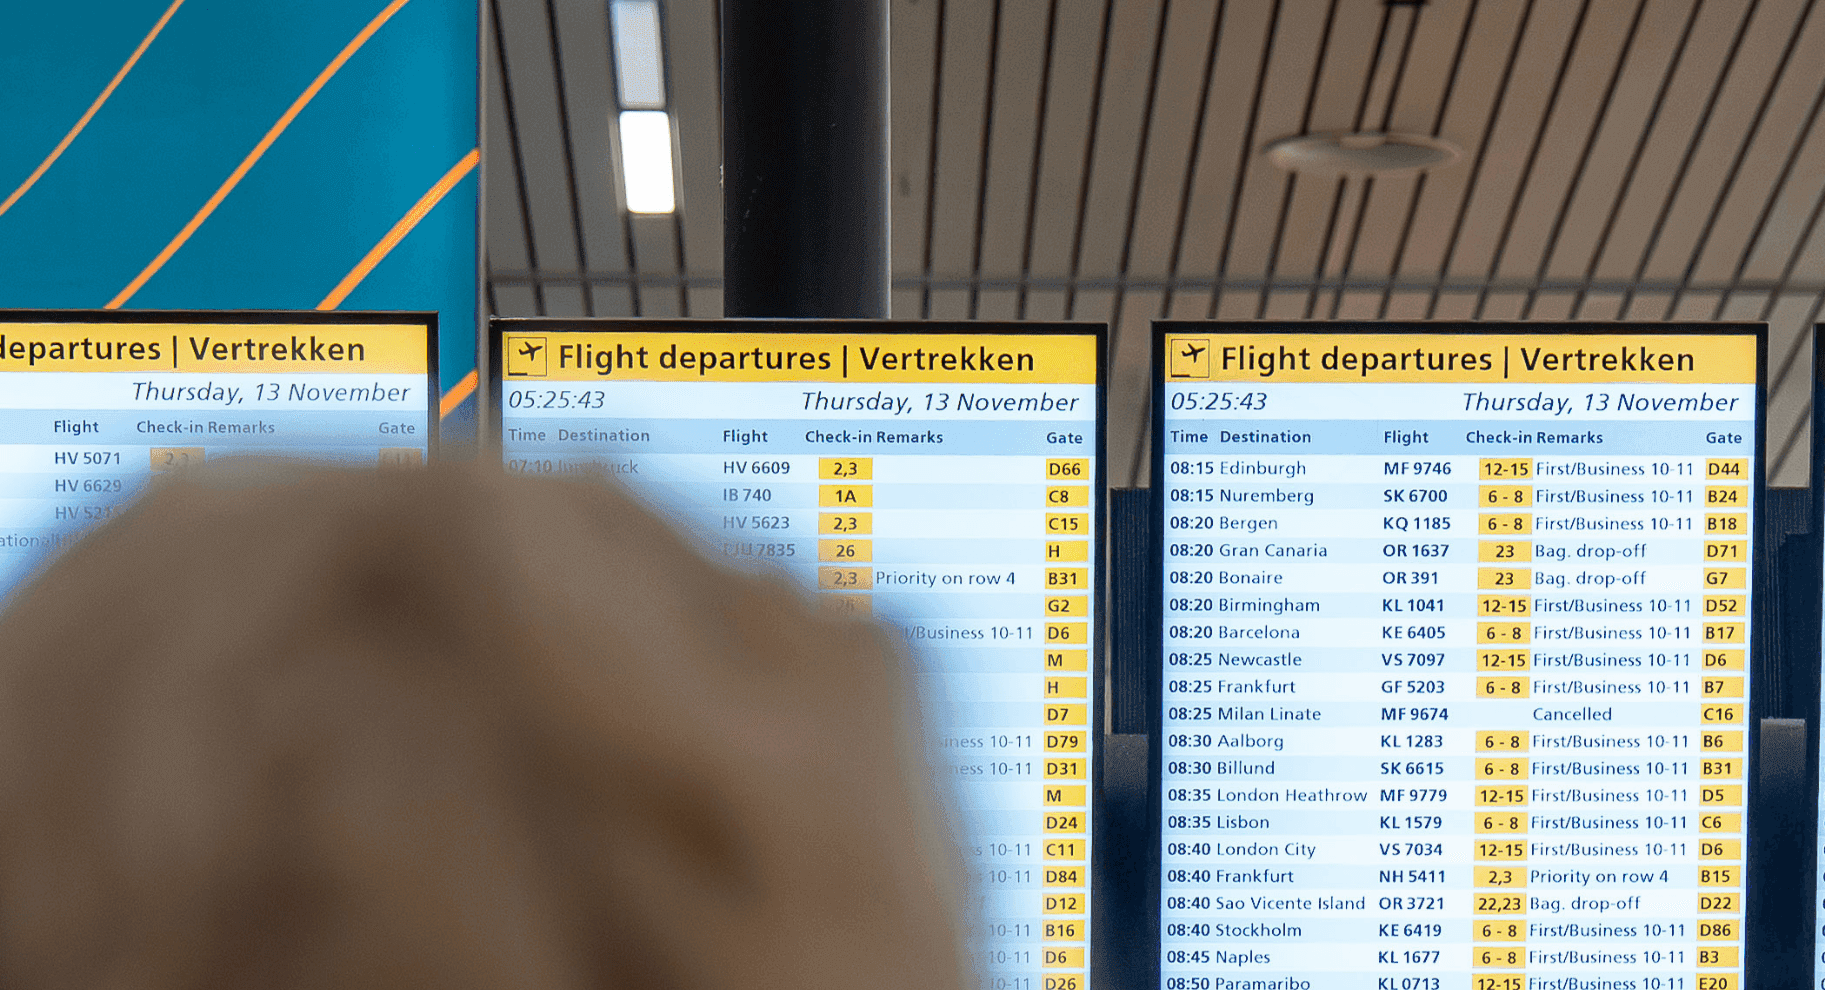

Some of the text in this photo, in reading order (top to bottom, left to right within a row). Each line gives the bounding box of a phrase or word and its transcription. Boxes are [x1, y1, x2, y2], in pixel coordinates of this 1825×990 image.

[188, 335, 365, 362] Vertrekken
[559, 343, 649, 376] Flight
[659, 343, 831, 376] departures
[859, 345, 1034, 372] Vertrekken
[1222, 344, 1311, 378] Flight
[1321, 345, 1492, 377] departures
[1520, 345, 1694, 371] Vertrekken
[132, 380, 411, 406] Thursday, 13 November
[508, 390, 1080, 416] 05:25:43 Thursday, 13 November
[1171, 391, 1740, 416] 05:25:43 Thursday, 13 November
[54, 419, 416, 436] Flight Check-in Remarks Gate
[508, 427, 1083, 446] Time Destination Flight Check-in Remarks Gate
[1169, 429, 1743, 447] Time Destination Flight Check-in Remarks Gate
[54, 451, 120, 465] HV 5071
[723, 461, 1081, 478] HV 6609 2,3 D66
[1170, 460, 1740, 478] 08:15 Edinburgh MF 9746 12-15 First/Business 10-11 D44
[55, 479, 124, 494] HV 6629
[1169, 543, 1737, 562] 08:20 Gran Canaria OR 1637 23 Bag. drop-off D71
[876, 570, 1077, 589] Priority on row 4 B31
[1168, 706, 1734, 721] 08:25 Milan Linate MF 9674 Cancelled C16
[1045, 923, 1075, 937] B16
